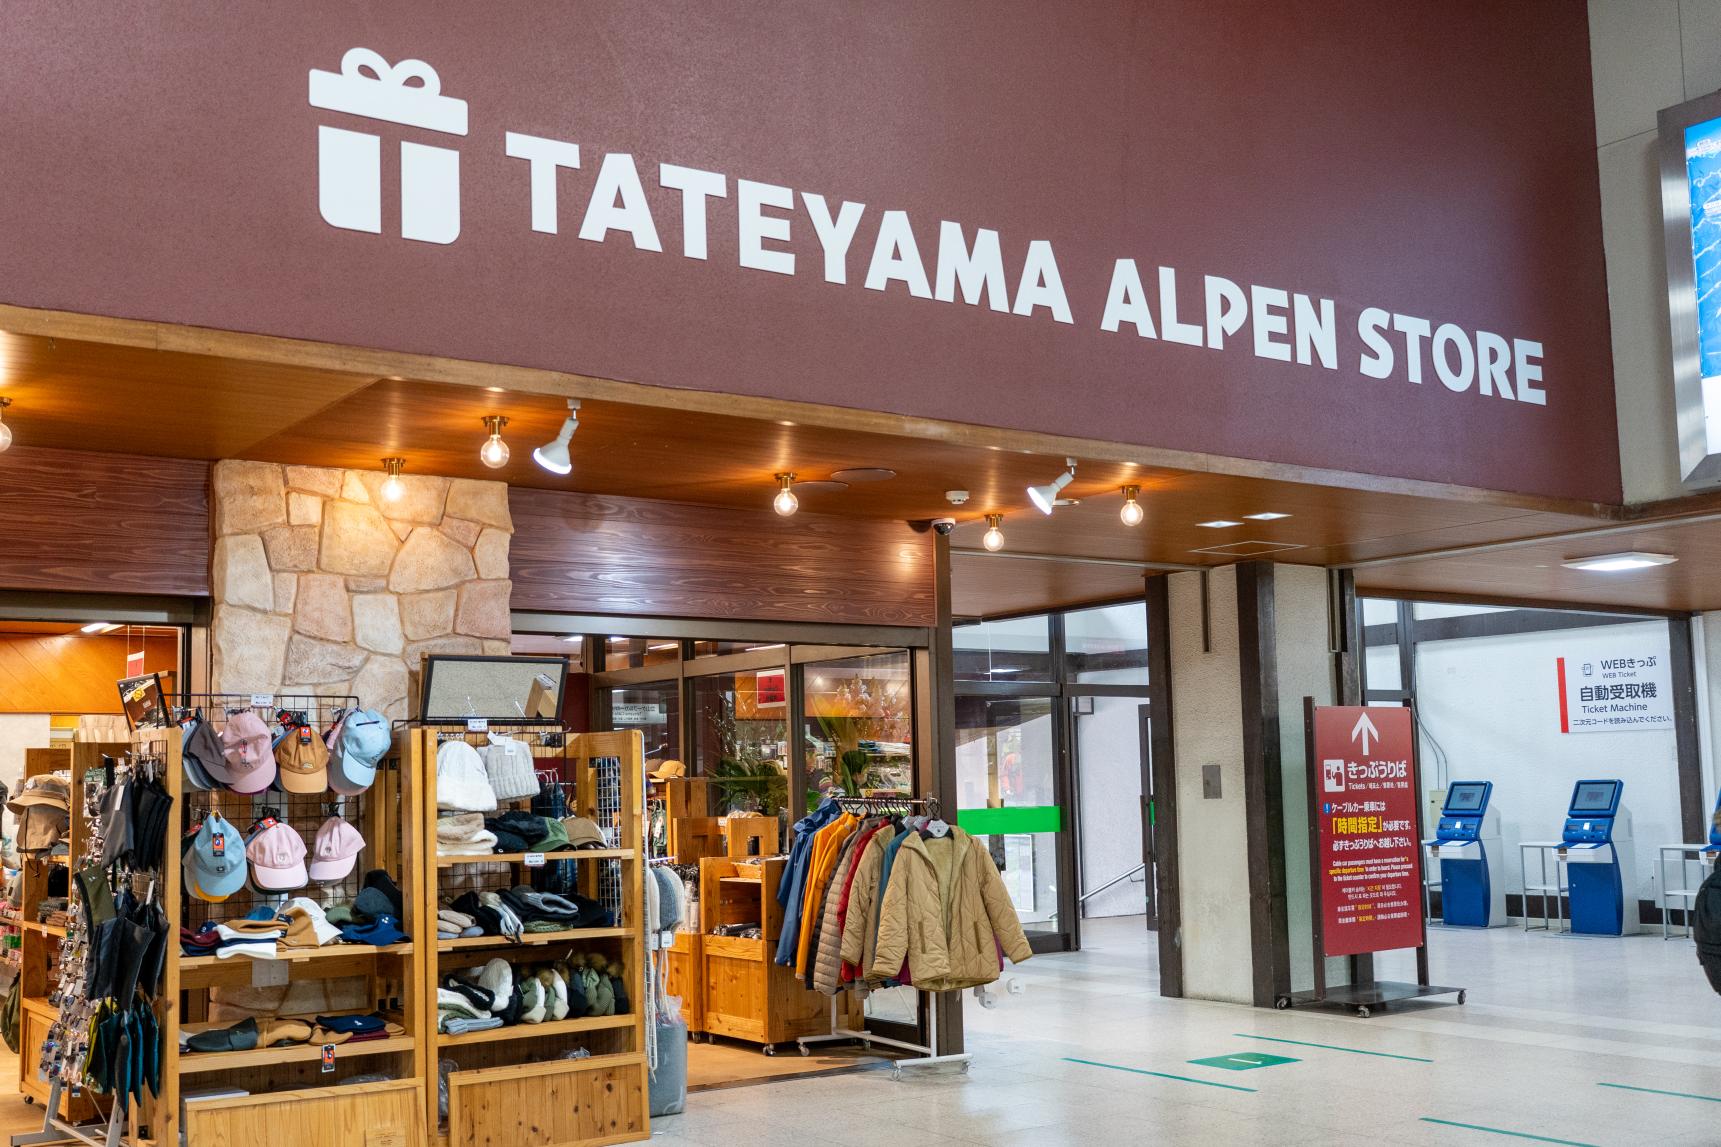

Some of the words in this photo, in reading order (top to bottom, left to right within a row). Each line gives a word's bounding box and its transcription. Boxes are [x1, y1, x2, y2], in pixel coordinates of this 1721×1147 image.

[505, 130, 1074, 324] TATEYAMA
[1100, 258, 1338, 370] ALPEN
[1357, 307, 1547, 406] STORE
[1600, 656, 1656, 670] WEBきっぷ
[1580, 682, 1657, 702] 自動受取機
[1582, 705, 1608, 714] Ticket
[1610, 703, 1648, 712] Machine
[1348, 760, 1407, 778] きっぷうりば
[1332, 801, 1386, 814] ケーブルカー乗車には
